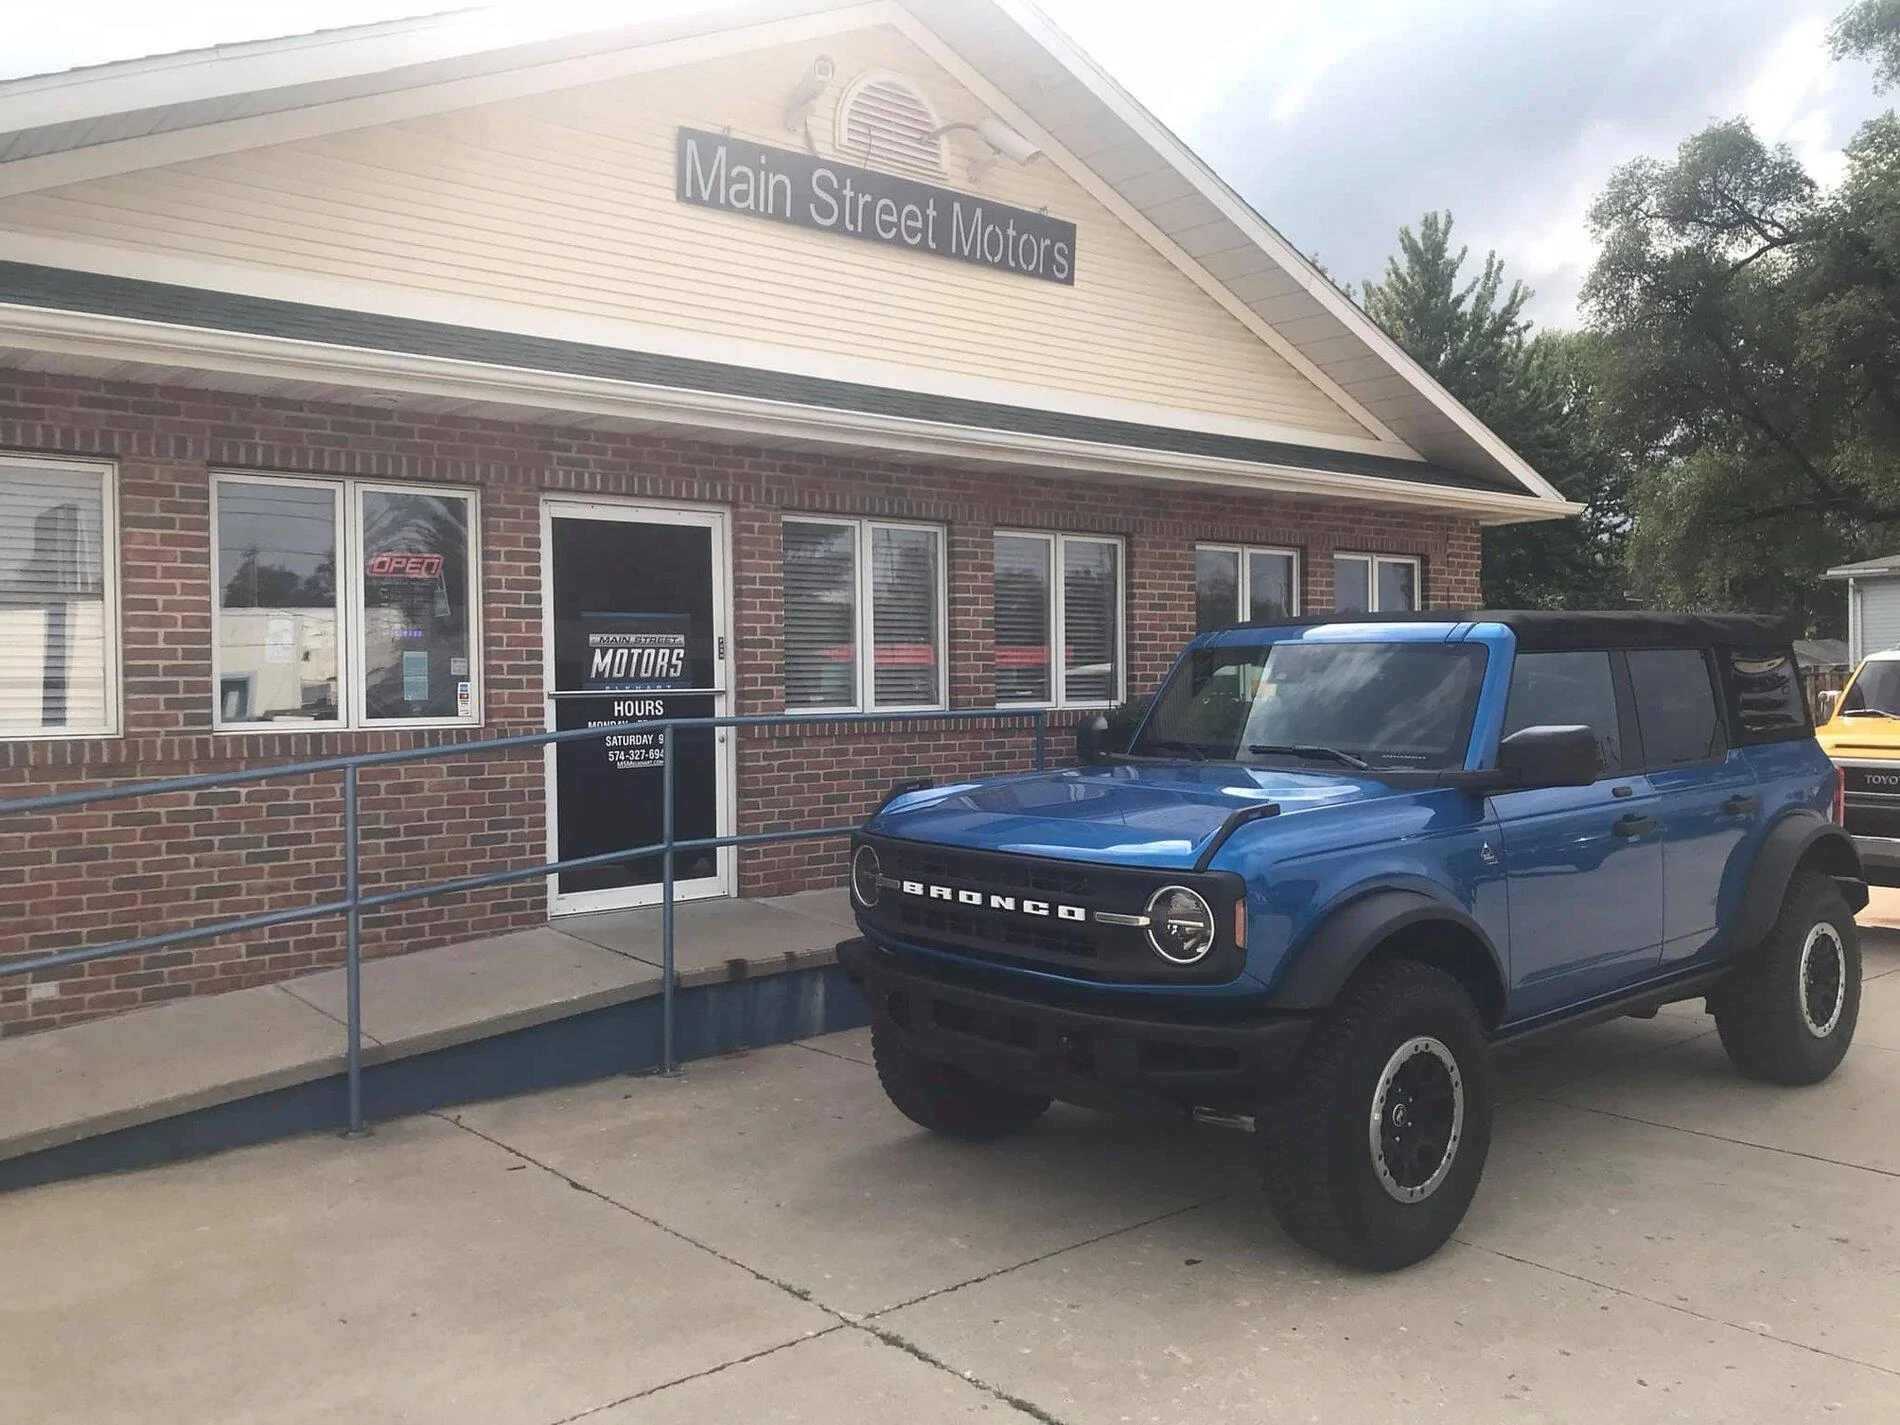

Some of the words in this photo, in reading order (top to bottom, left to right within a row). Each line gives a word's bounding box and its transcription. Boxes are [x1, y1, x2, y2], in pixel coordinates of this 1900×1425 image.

[684, 138, 793, 217] Main
[809, 167, 937, 250] Street
[951, 201, 1070, 280] Motors
[371, 556, 440, 576] OPEN
[599, 636, 631, 645] MAIN
[634, 636, 679, 645] STREET
[590, 648, 685, 679] MOTORS
[614, 700, 664, 717] HOURS
[605, 734, 654, 747] SATURDAY
[608, 749, 664, 761] 574-327-694
[1864, 774, 1900, 785] TOYO
[902, 880, 1086, 922] BRONCO
